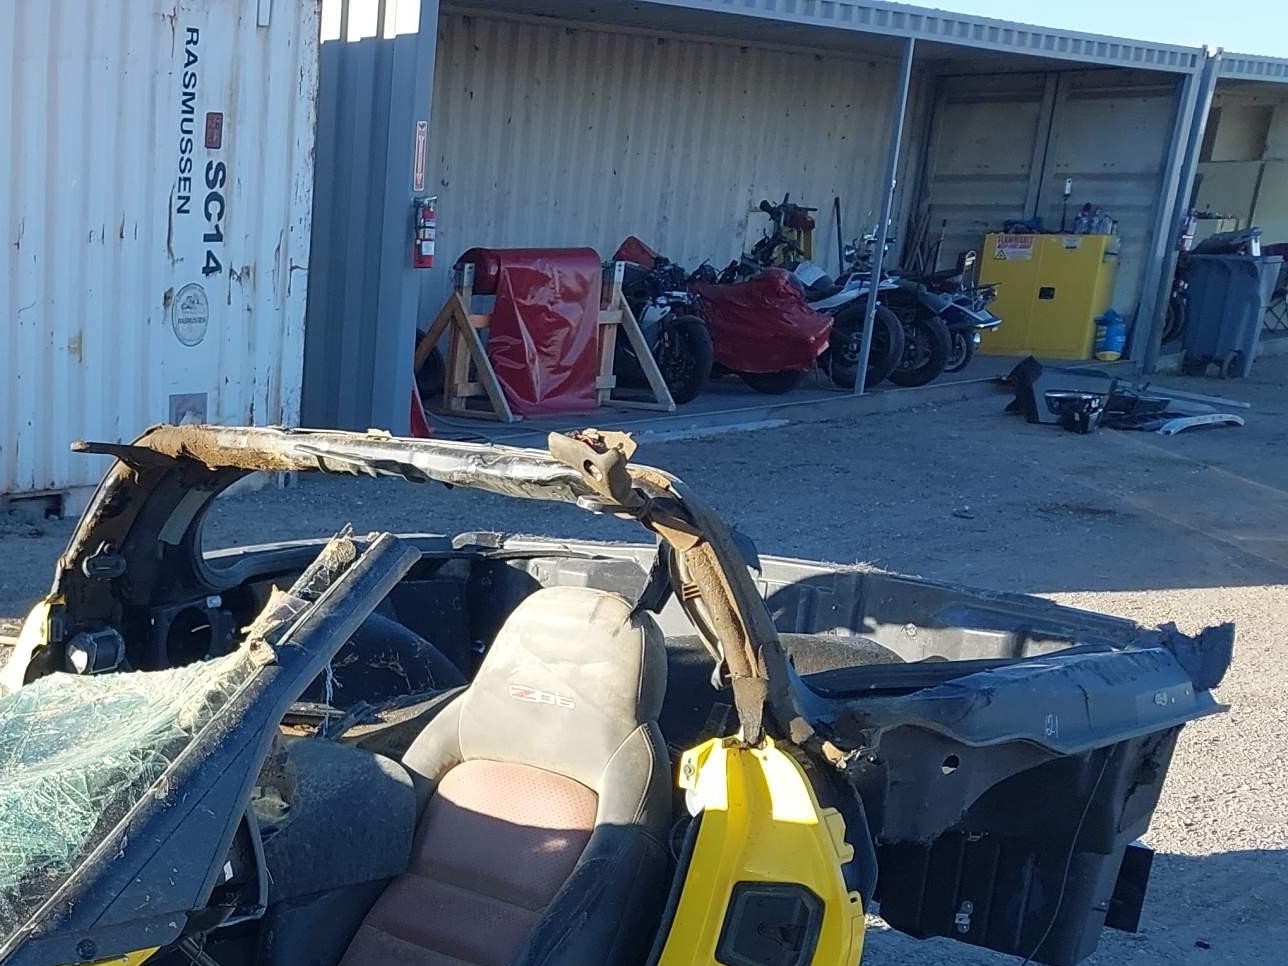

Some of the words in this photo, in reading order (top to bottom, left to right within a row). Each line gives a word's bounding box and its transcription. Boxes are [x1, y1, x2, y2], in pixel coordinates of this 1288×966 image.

[177, 27, 200, 214] RASMUSSEN
[202, 159, 226, 277] SC14
[508, 685, 576, 710] Z06
